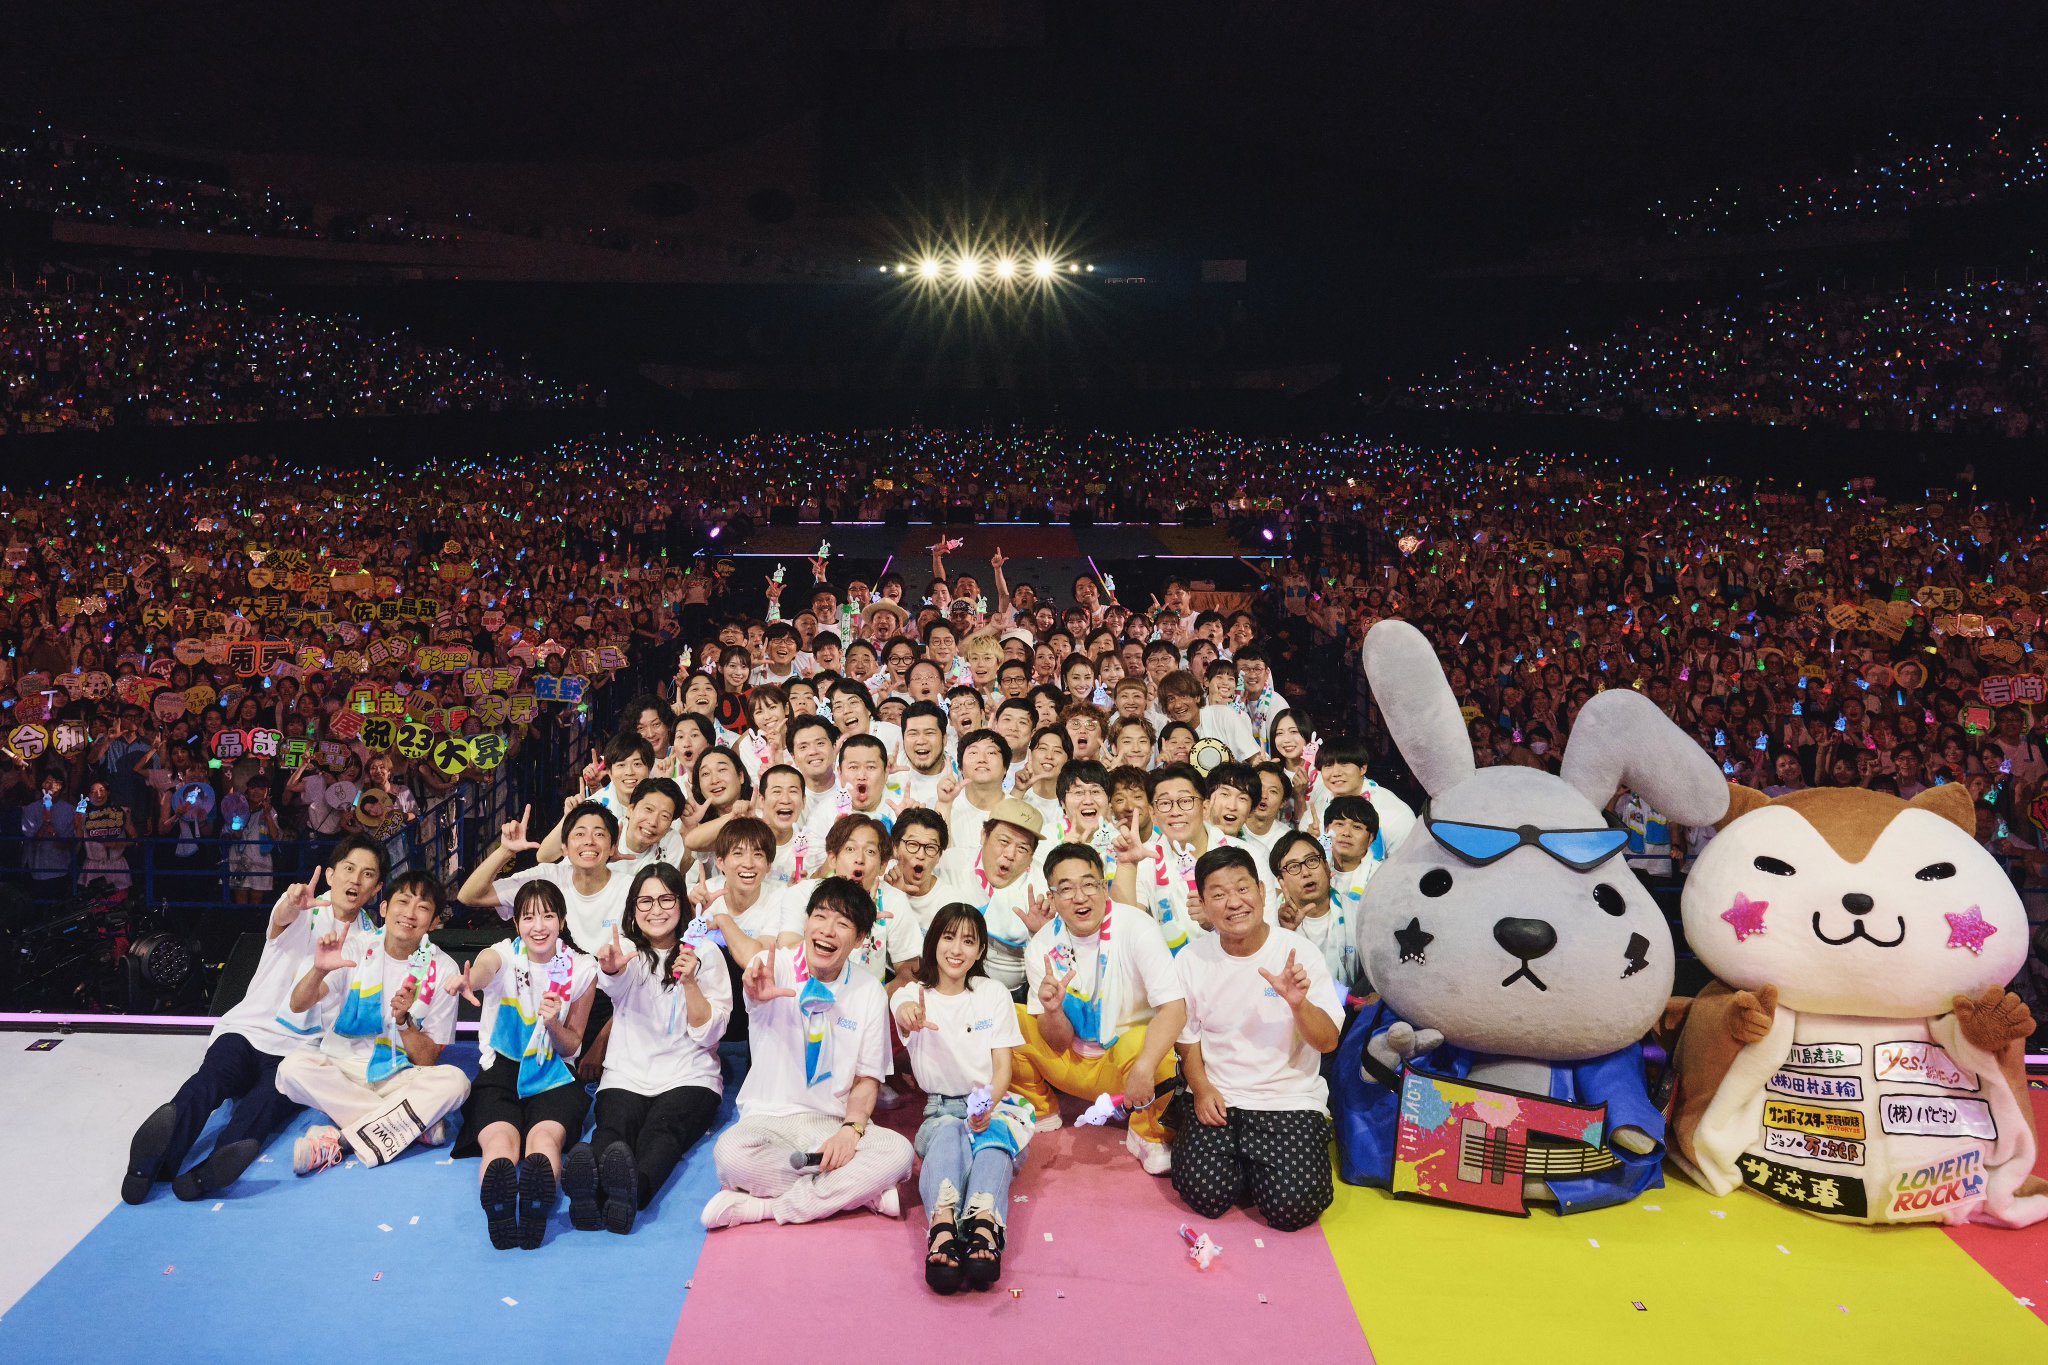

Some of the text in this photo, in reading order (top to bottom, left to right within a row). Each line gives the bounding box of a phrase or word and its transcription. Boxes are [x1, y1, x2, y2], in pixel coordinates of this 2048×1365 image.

[243, 596, 283, 619] 大昇
[480, 697, 534, 720] 大昇
[12, 725, 84, 757] 令和
[363, 719, 391, 749] 祝
[398, 725, 433, 751] 23
[438, 735, 503, 769] 大昇
[1404, 1079, 1423, 1124] LOVE
[1770, 1073, 1857, 1098] (株)田村運輸
[372, 1123, 398, 1157] HOWL
[1893, 1180, 1962, 1213] ROCK
